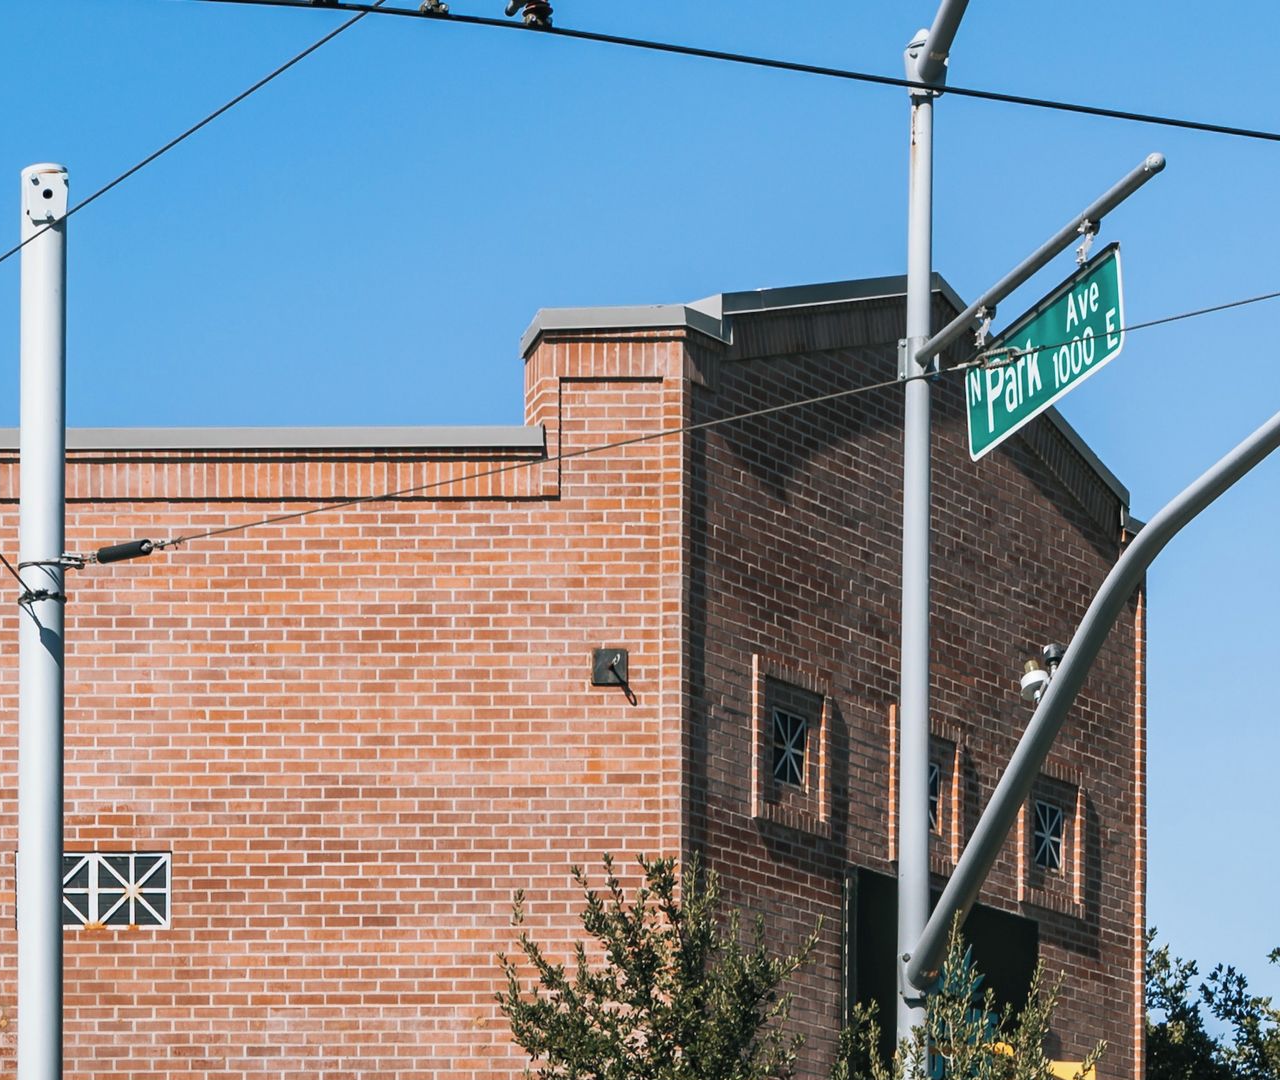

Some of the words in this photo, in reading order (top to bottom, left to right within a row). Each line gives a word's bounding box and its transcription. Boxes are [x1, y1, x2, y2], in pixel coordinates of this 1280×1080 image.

[1052, 326, 1095, 389] 1000
[1105, 307, 1118, 350] E
[1066, 282, 1100, 333] Ave
[970, 368, 982, 407] N
[985, 338, 1042, 433] Park
